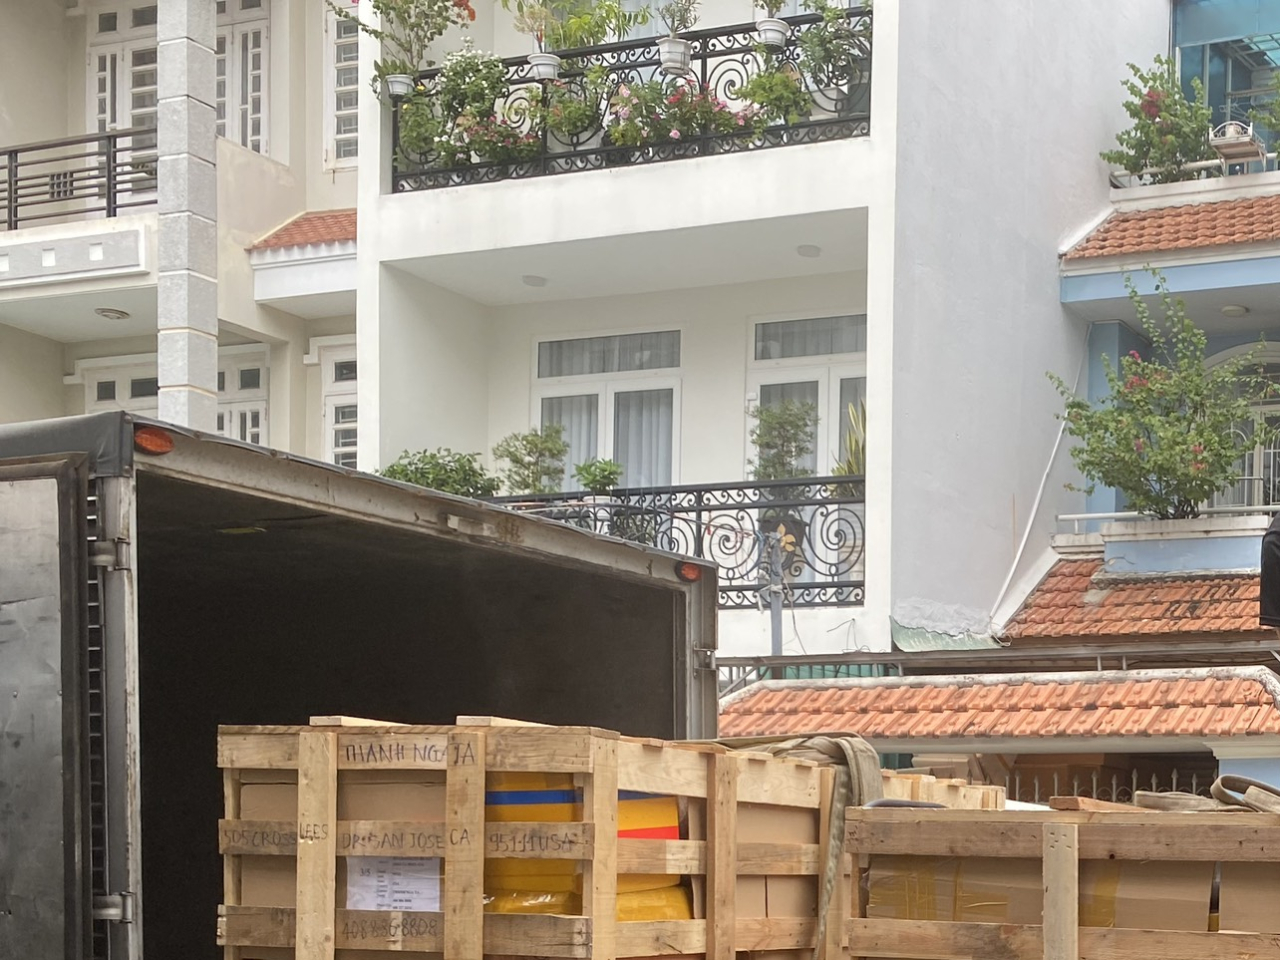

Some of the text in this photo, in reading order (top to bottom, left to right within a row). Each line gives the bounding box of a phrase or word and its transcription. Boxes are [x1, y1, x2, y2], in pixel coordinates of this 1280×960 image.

[345, 742, 405, 763] THANH
[411, 832, 445, 849] JOSE
[450, 828, 471, 846] CA
